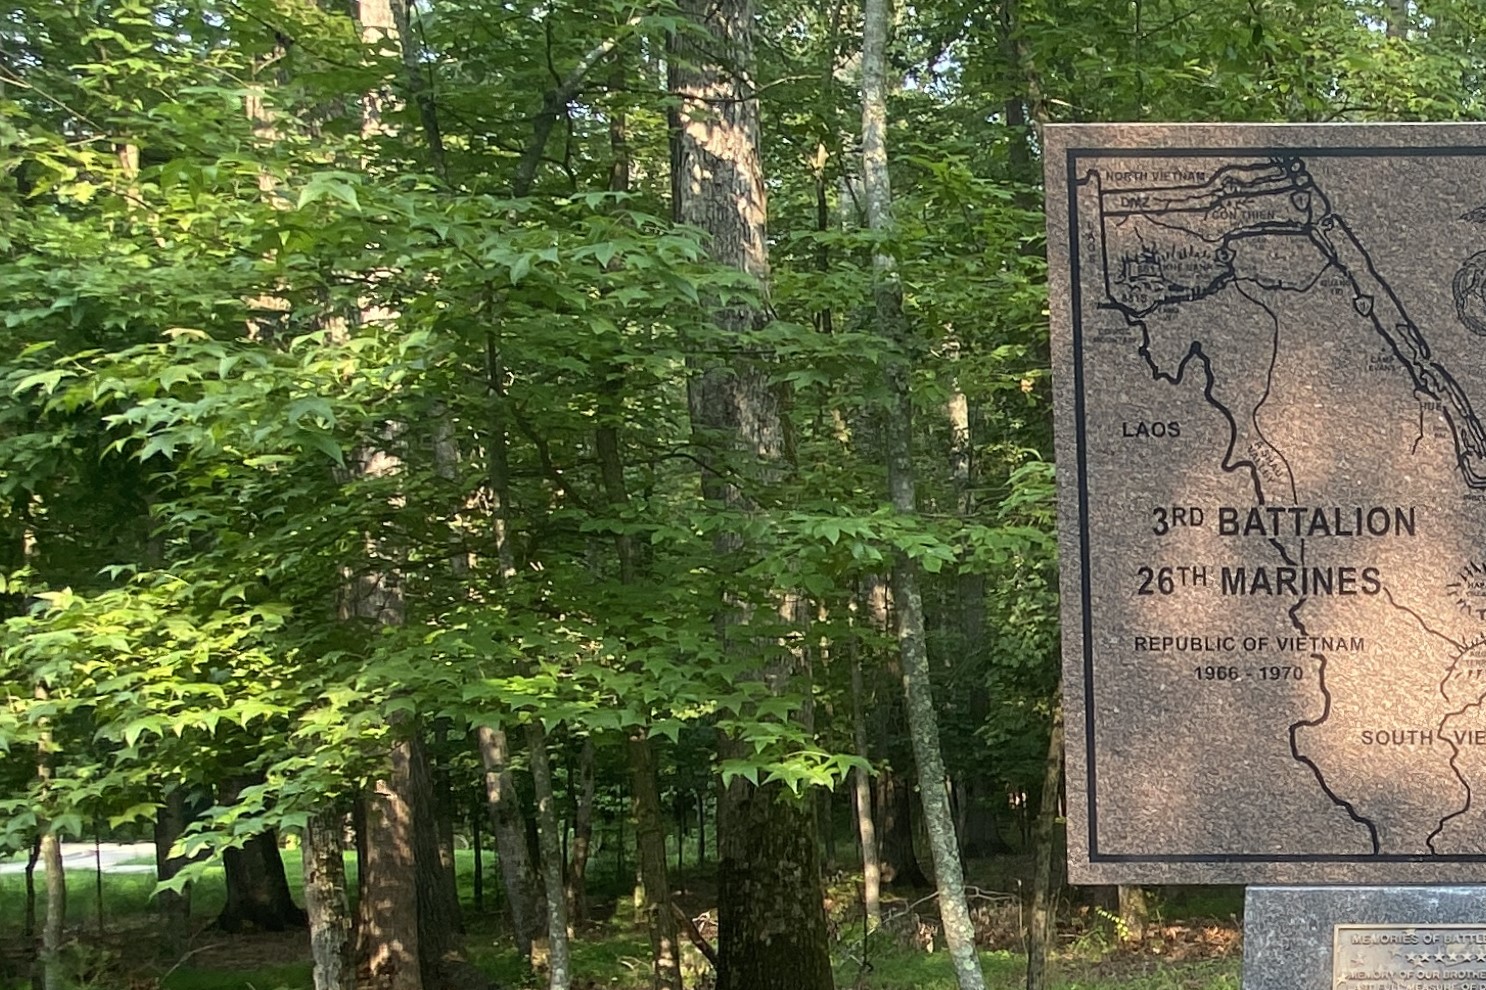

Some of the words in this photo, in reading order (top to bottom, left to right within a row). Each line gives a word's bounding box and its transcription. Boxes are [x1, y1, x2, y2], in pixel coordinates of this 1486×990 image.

[1106, 171, 1148, 182] NORTH
[1152, 171, 1205, 181] VIETNAM
[1120, 196, 1150, 208] DMZ
[1212, 209, 1236, 220] CON
[1241, 210, 1275, 220] THIEN
[1420, 401, 1443, 411] HUE
[1122, 421, 1181, 438] LAOS
[1152, 506, 1204, 537] 3RD
[1218, 506, 1416, 537] BATTALION
[1137, 565, 1207, 597] 26TH
[1221, 565, 1382, 597] MARINES
[1134, 636, 1236, 653] REPUBLIC
[1243, 636, 1269, 652] OF
[1276, 636, 1365, 652] VIETNAM
[1194, 665, 1239, 682] 1966
[1259, 665, 1304, 681] 1970
[1361, 730, 1434, 746] SOUTH
[1352, 933, 1420, 945] MEMORIES
[1423, 933, 1441, 945] OF
[1348, 970, 1397, 981] MEMORY
[1400, 970, 1415, 981] OF
[1416, 970, 1441, 981] OUR
